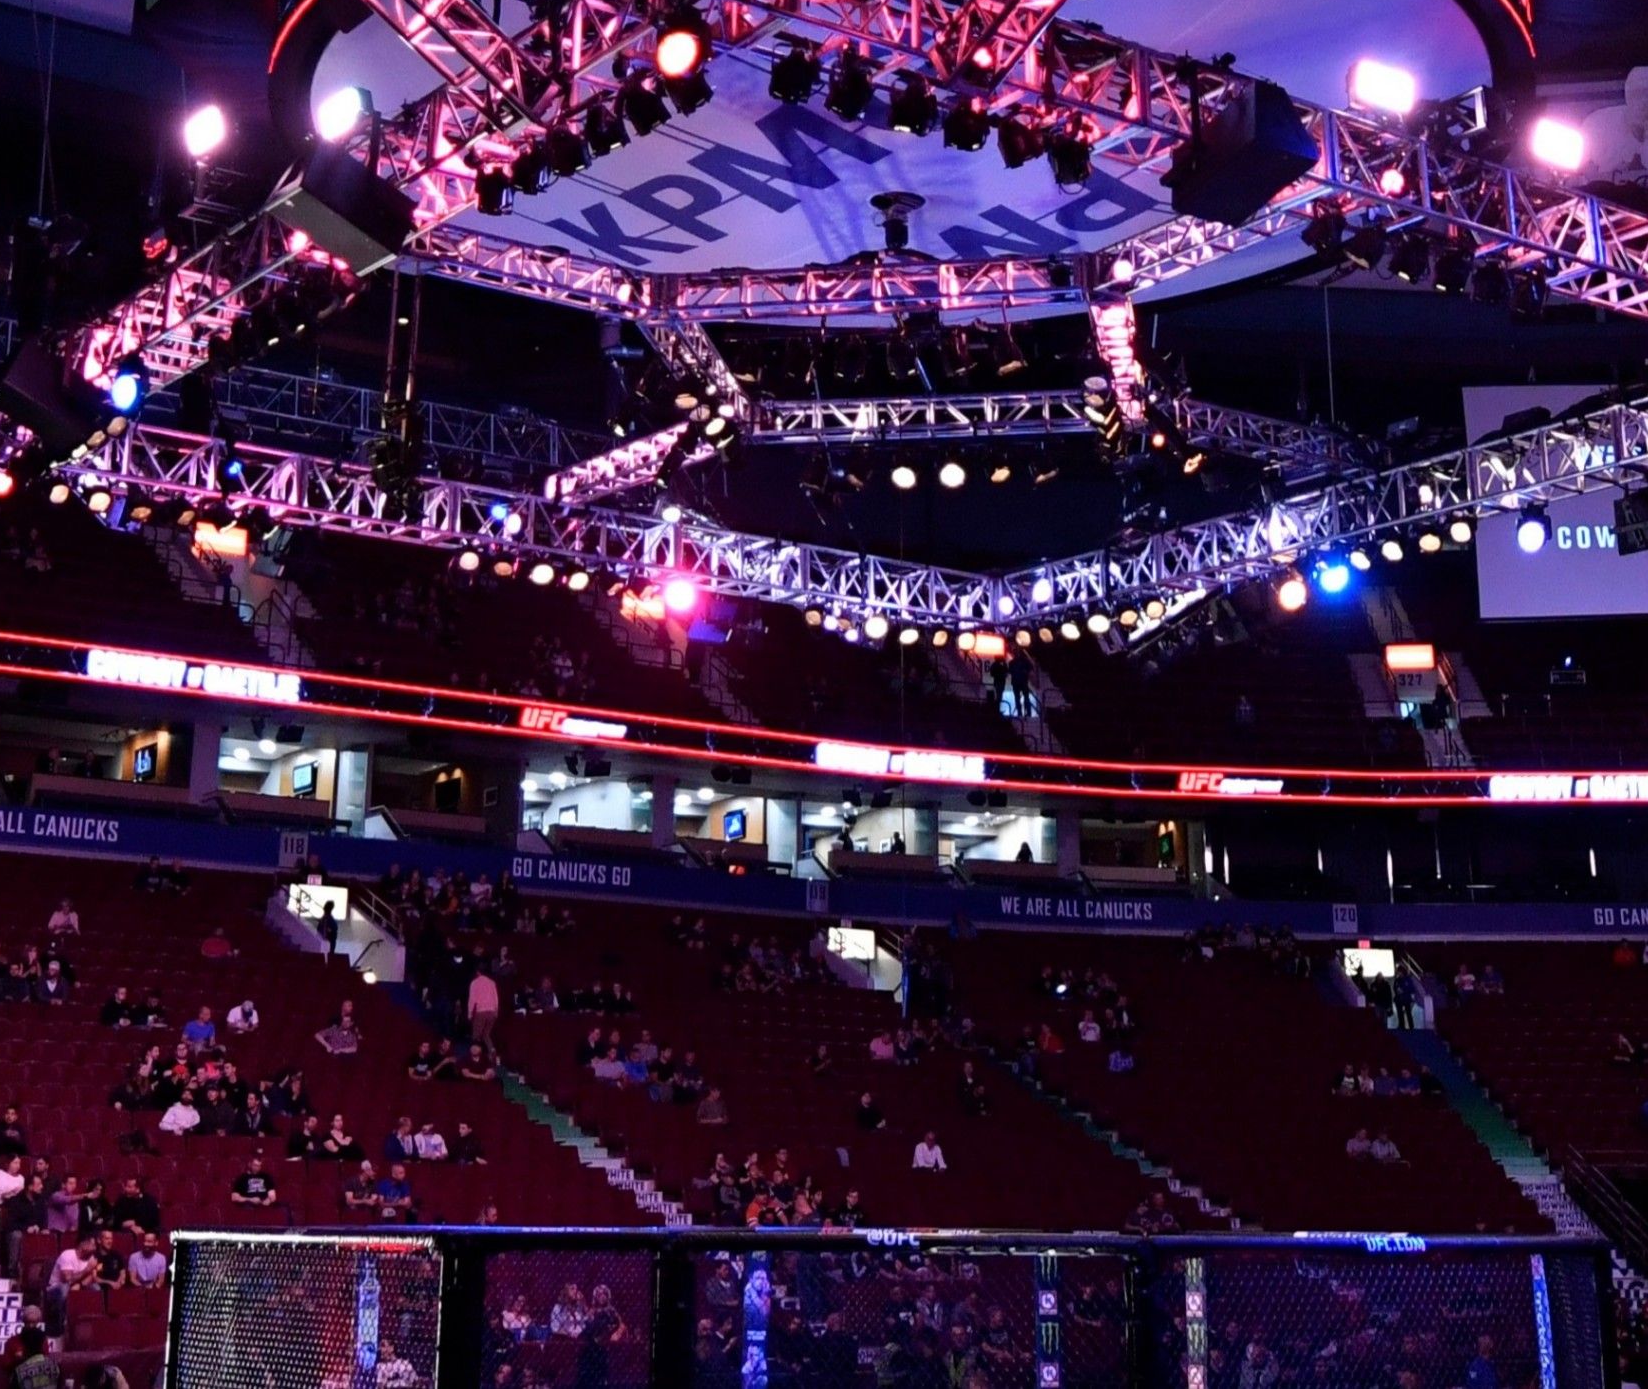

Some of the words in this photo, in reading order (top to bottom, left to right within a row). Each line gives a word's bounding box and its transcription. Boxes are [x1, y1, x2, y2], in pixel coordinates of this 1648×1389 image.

[1557, 523, 1617, 550] COW
[1398, 673, 1424, 687] 327
[520, 707, 567, 732] UFC
[1179, 771, 1224, 791] UFC
[32, 813, 120, 844] CANUCKS
[283, 838, 305, 855] 118
[511, 857, 534, 879] GO
[536, 859, 608, 886] CANUCKS
[611, 865, 633, 888] GO
[1000, 894, 1025, 915] WE
[1026, 896, 1053, 918] ARE
[1056, 898, 1080, 919] ALL
[1083, 900, 1154, 922] CANUCKS
[1334, 906, 1357, 922] 120
[1592, 907, 1616, 927] GO
[866, 1229, 921, 1247] @UFC
[1364, 1236, 1426, 1252] UFC.COM
